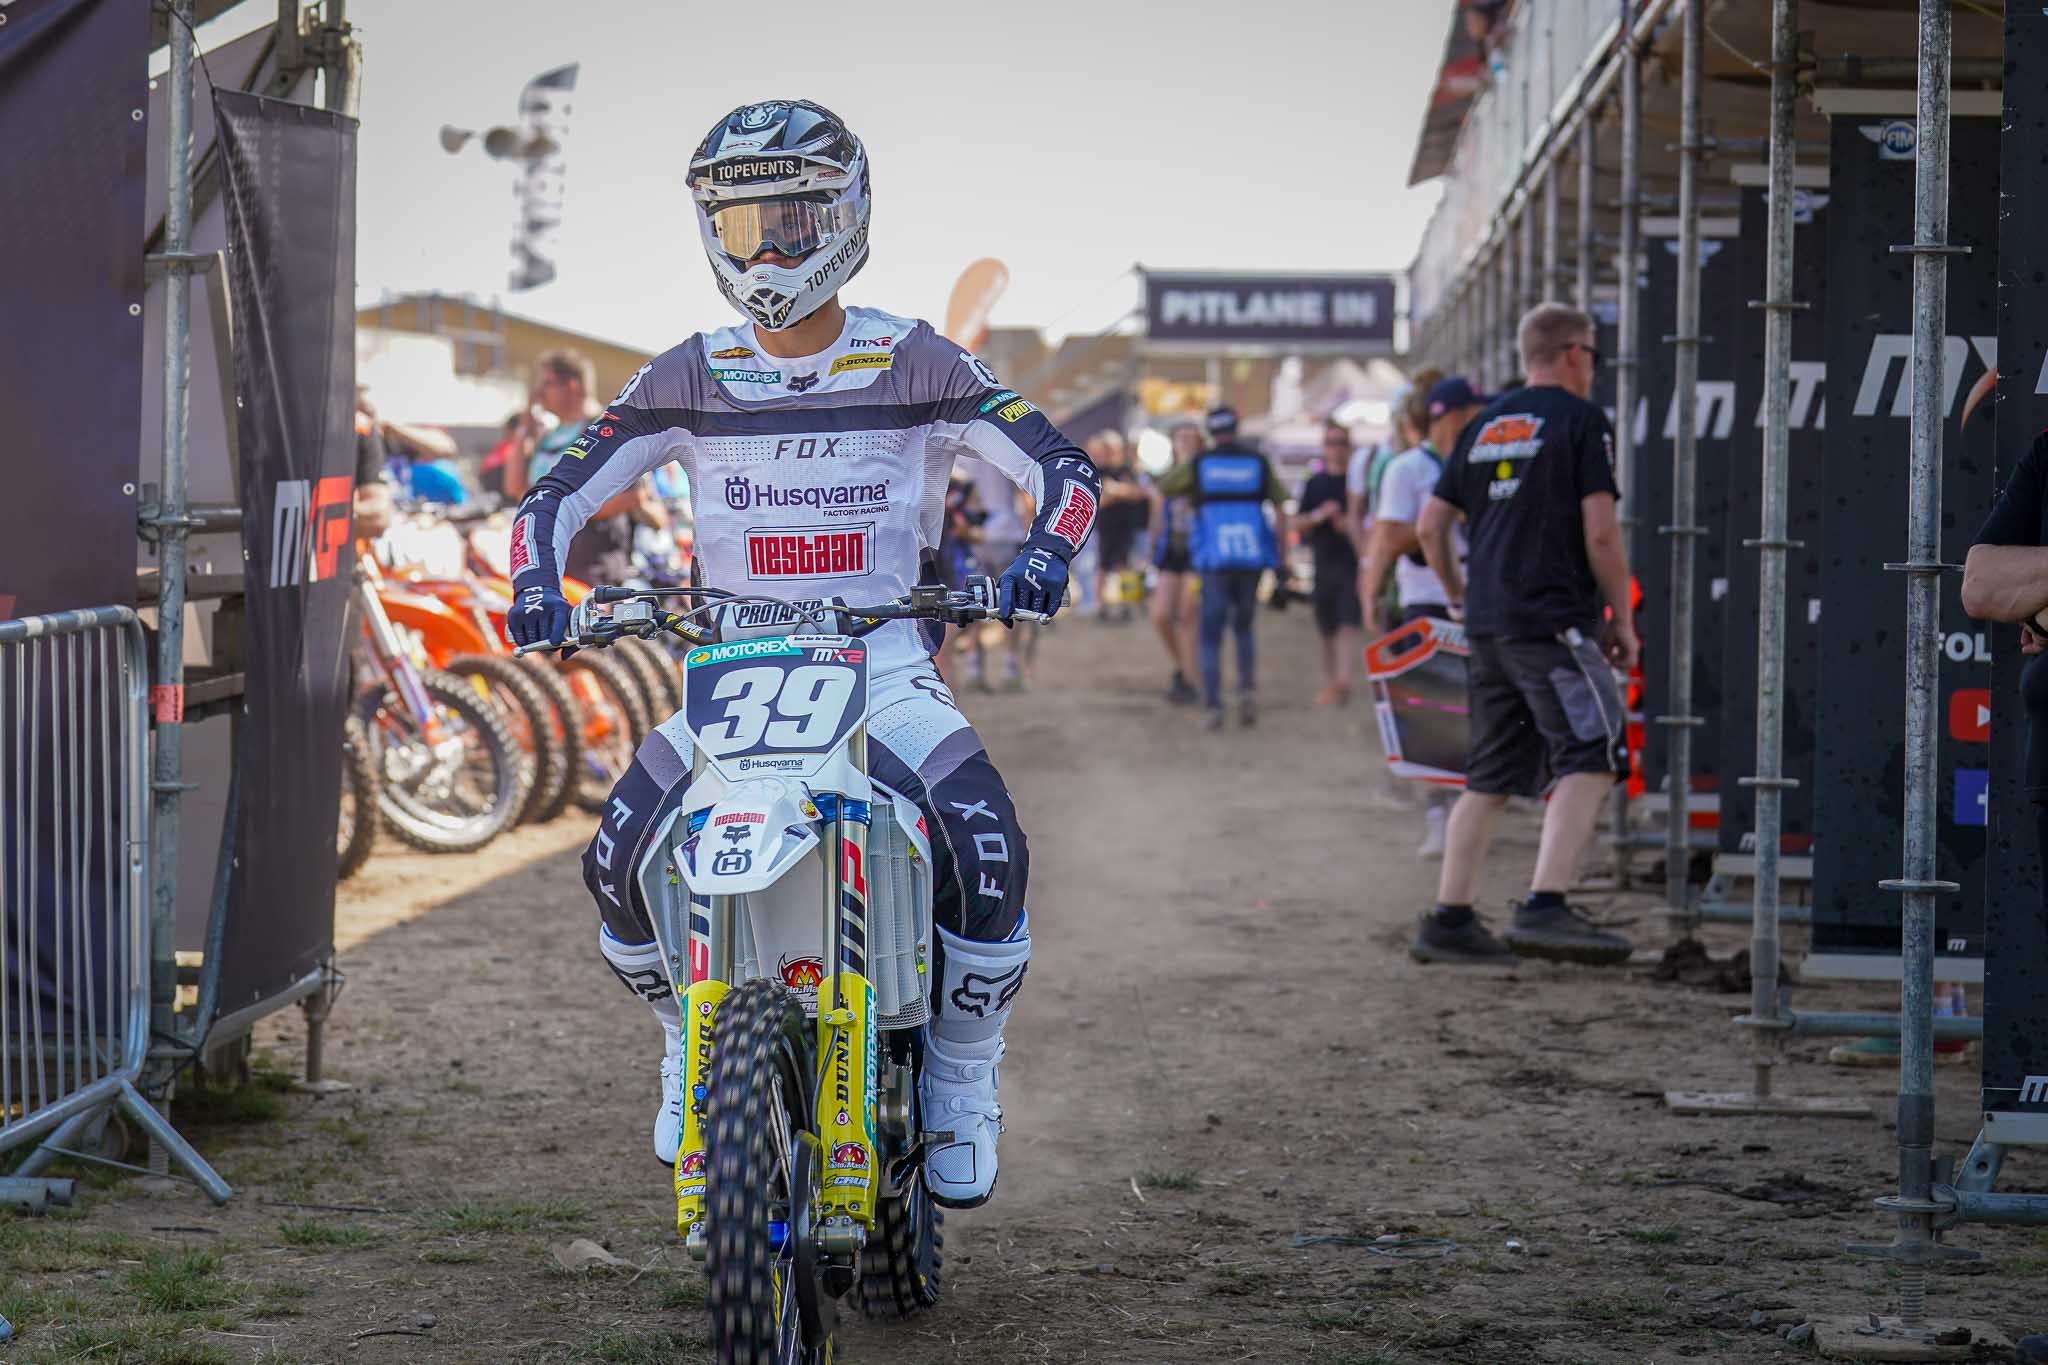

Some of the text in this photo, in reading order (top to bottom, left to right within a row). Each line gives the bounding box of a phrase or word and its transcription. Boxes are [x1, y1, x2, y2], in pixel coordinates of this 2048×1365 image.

[1160, 290, 1377, 327] PITLANE IN
[846, 357, 891, 365] DUNLOP
[723, 370, 779, 383] MOTOREX
[775, 437, 842, 460] FOX
[755, 482, 889, 509] Husqvarna
[823, 505, 890, 517] FACTORY RACING
[1025, 547, 1053, 590] FOX
[523, 586, 545, 614] FOX
[712, 640, 792, 661] MOTOREX
[699, 665, 857, 756] 39
[752, 759, 803, 768] Husqvarna
[950, 800, 1009, 900] FOX
